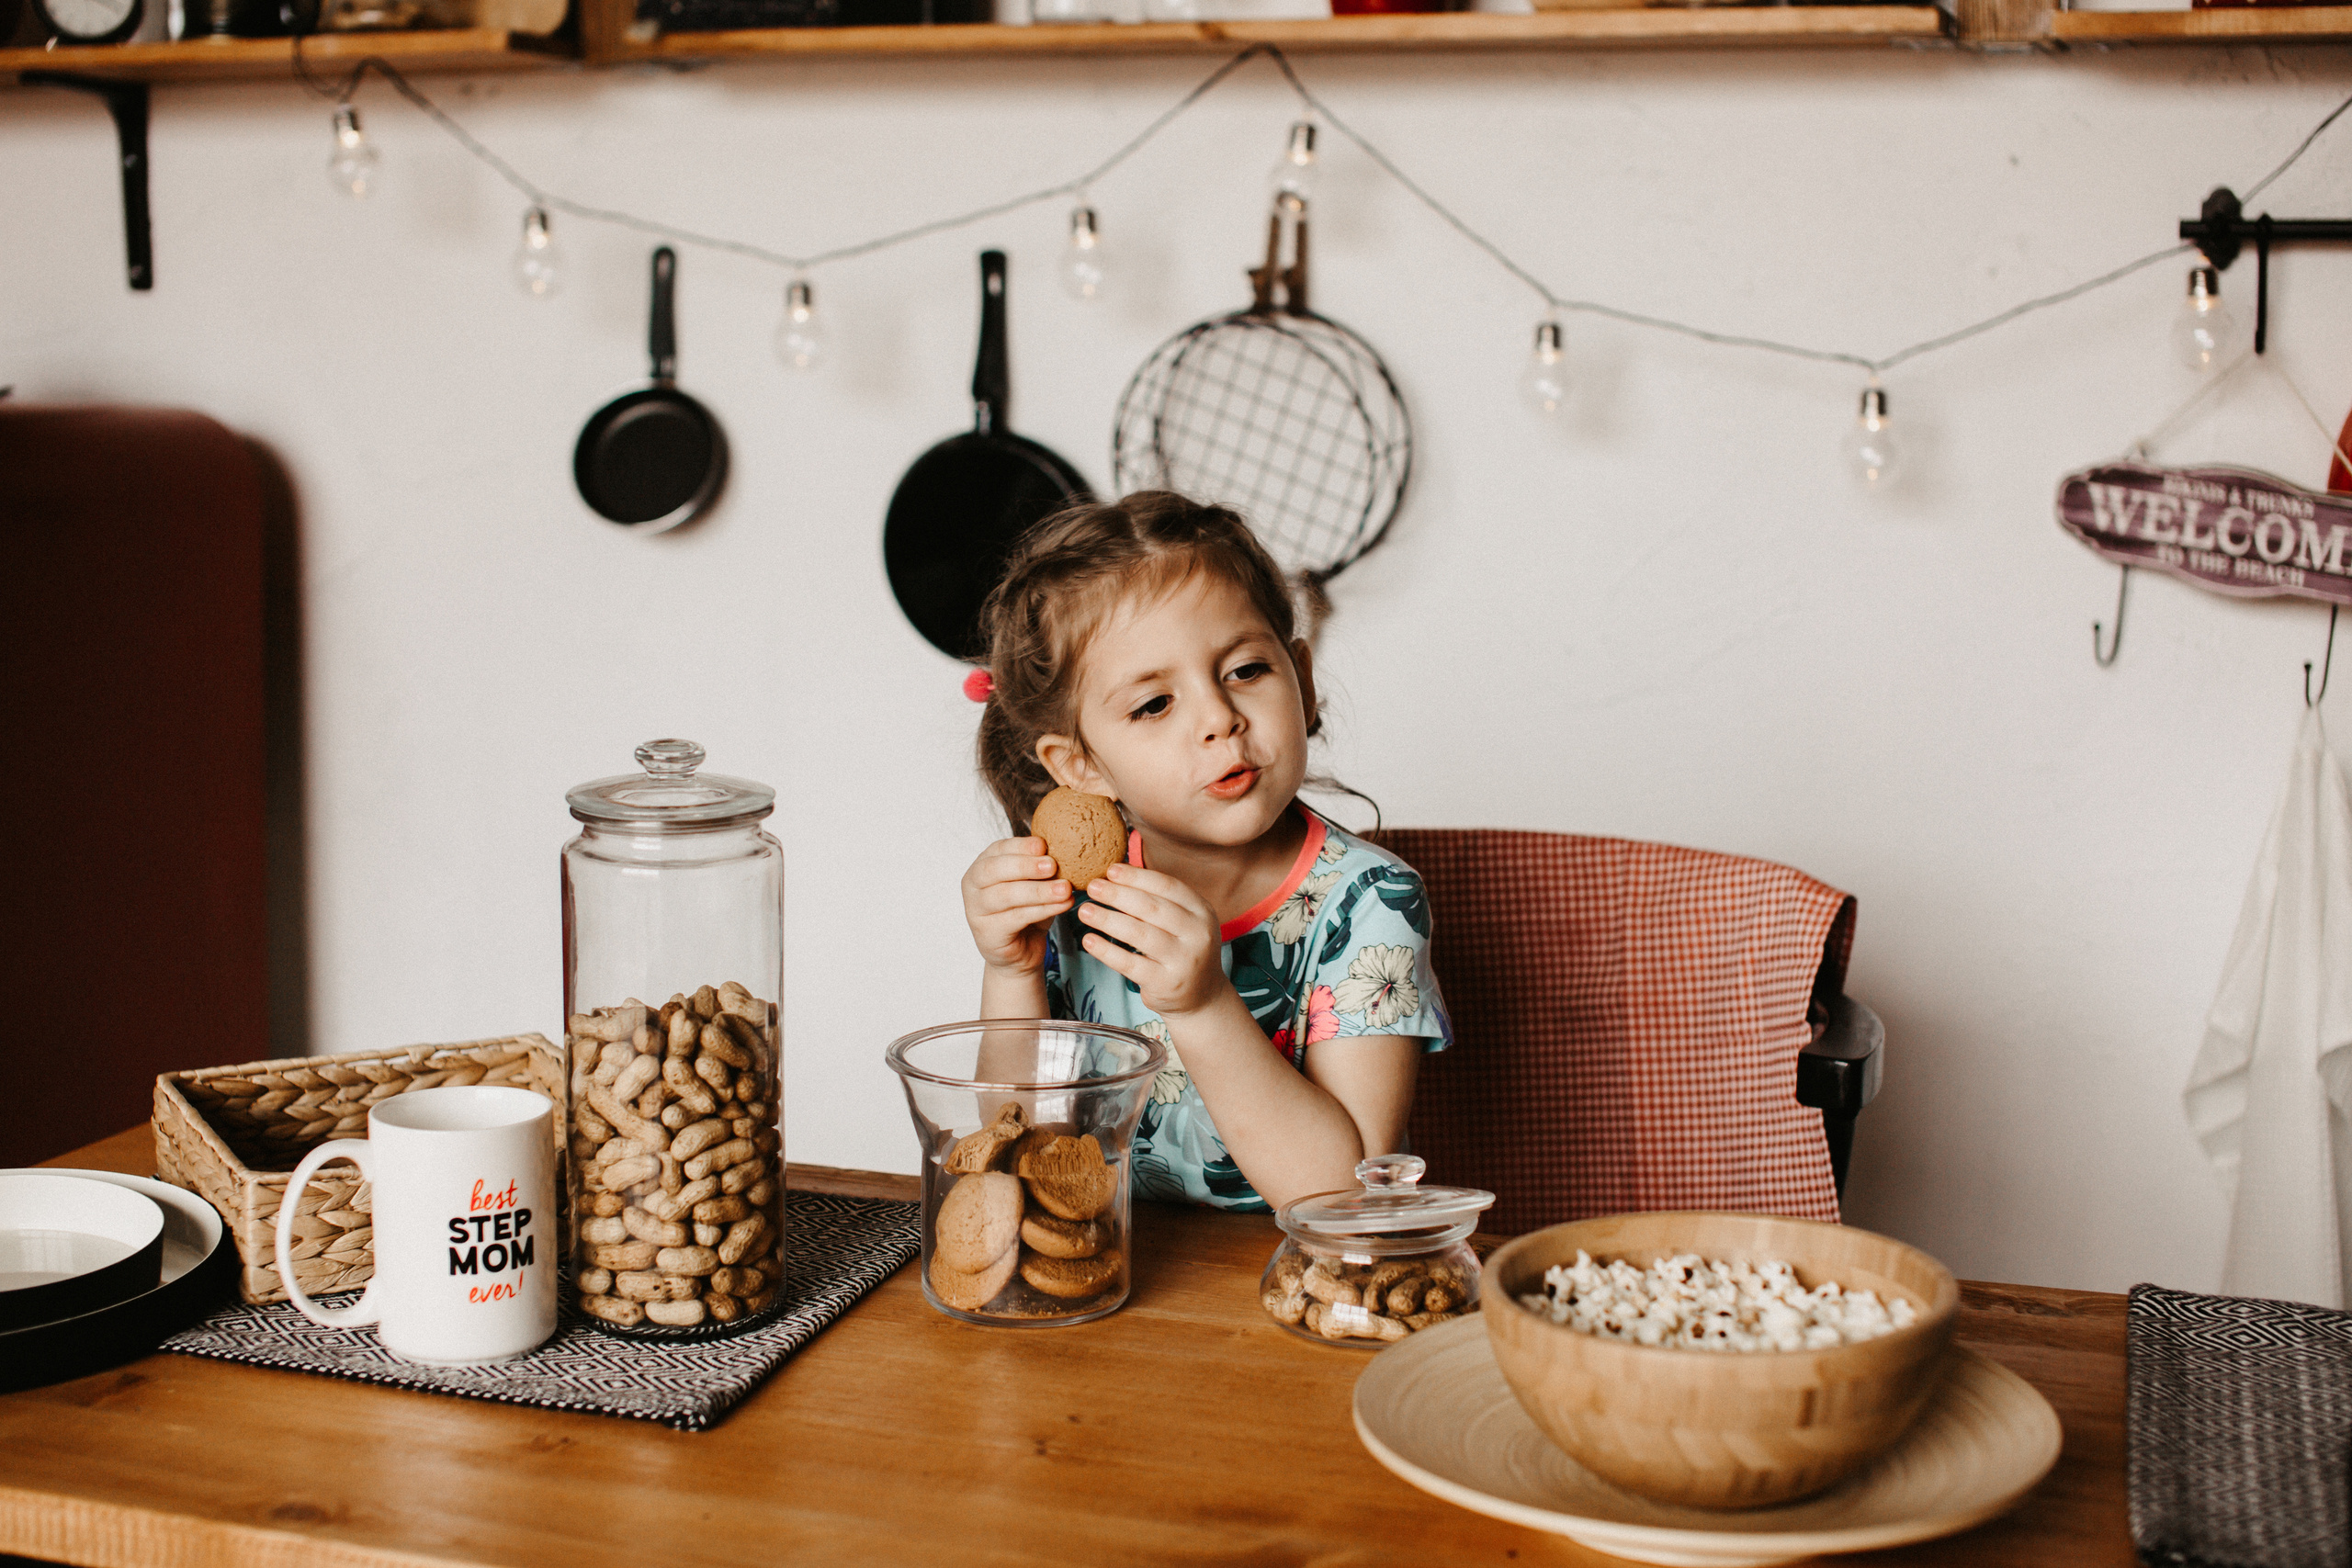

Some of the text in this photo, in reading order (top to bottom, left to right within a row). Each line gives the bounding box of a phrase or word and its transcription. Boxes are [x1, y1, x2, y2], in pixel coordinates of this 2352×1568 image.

[2087, 481, 2352, 575] WELCOM
[2157, 544, 2305, 586] TO THE BEACH
[469, 1179, 518, 1212] best
[448, 1208, 532, 1244] STEP
[448, 1235, 534, 1276] MOM
[469, 1270, 524, 1303] ever!
